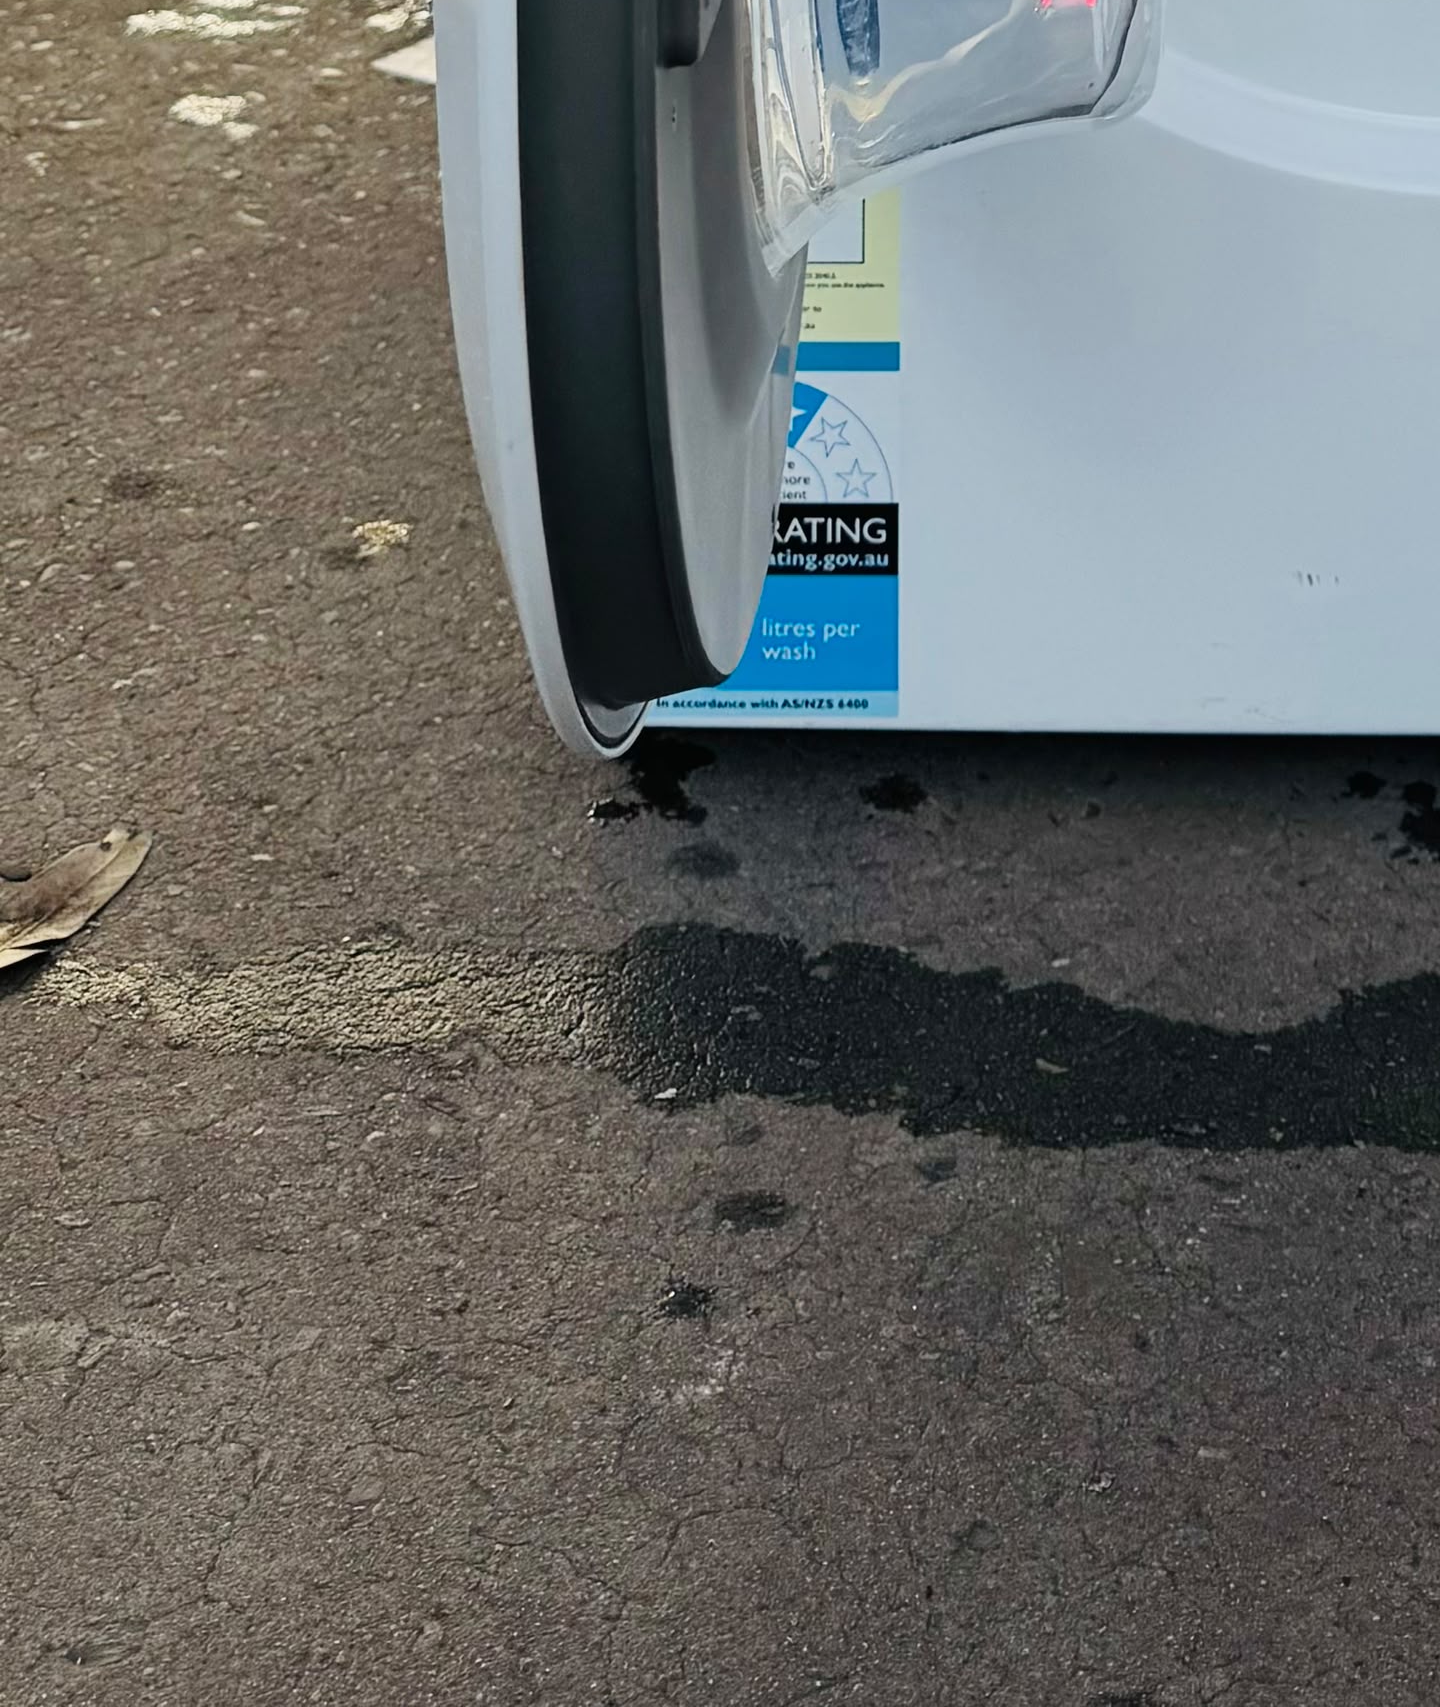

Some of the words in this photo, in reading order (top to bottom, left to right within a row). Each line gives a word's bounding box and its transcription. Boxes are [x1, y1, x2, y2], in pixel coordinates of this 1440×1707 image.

[761, 618, 816, 638] litres
[823, 622, 860, 643] per
[762, 640, 816, 660] wash
[672, 698, 747, 709] accordance
[750, 698, 779, 709] with
[781, 698, 834, 709] AS/NZS
[837, 698, 869, 709] 6400
